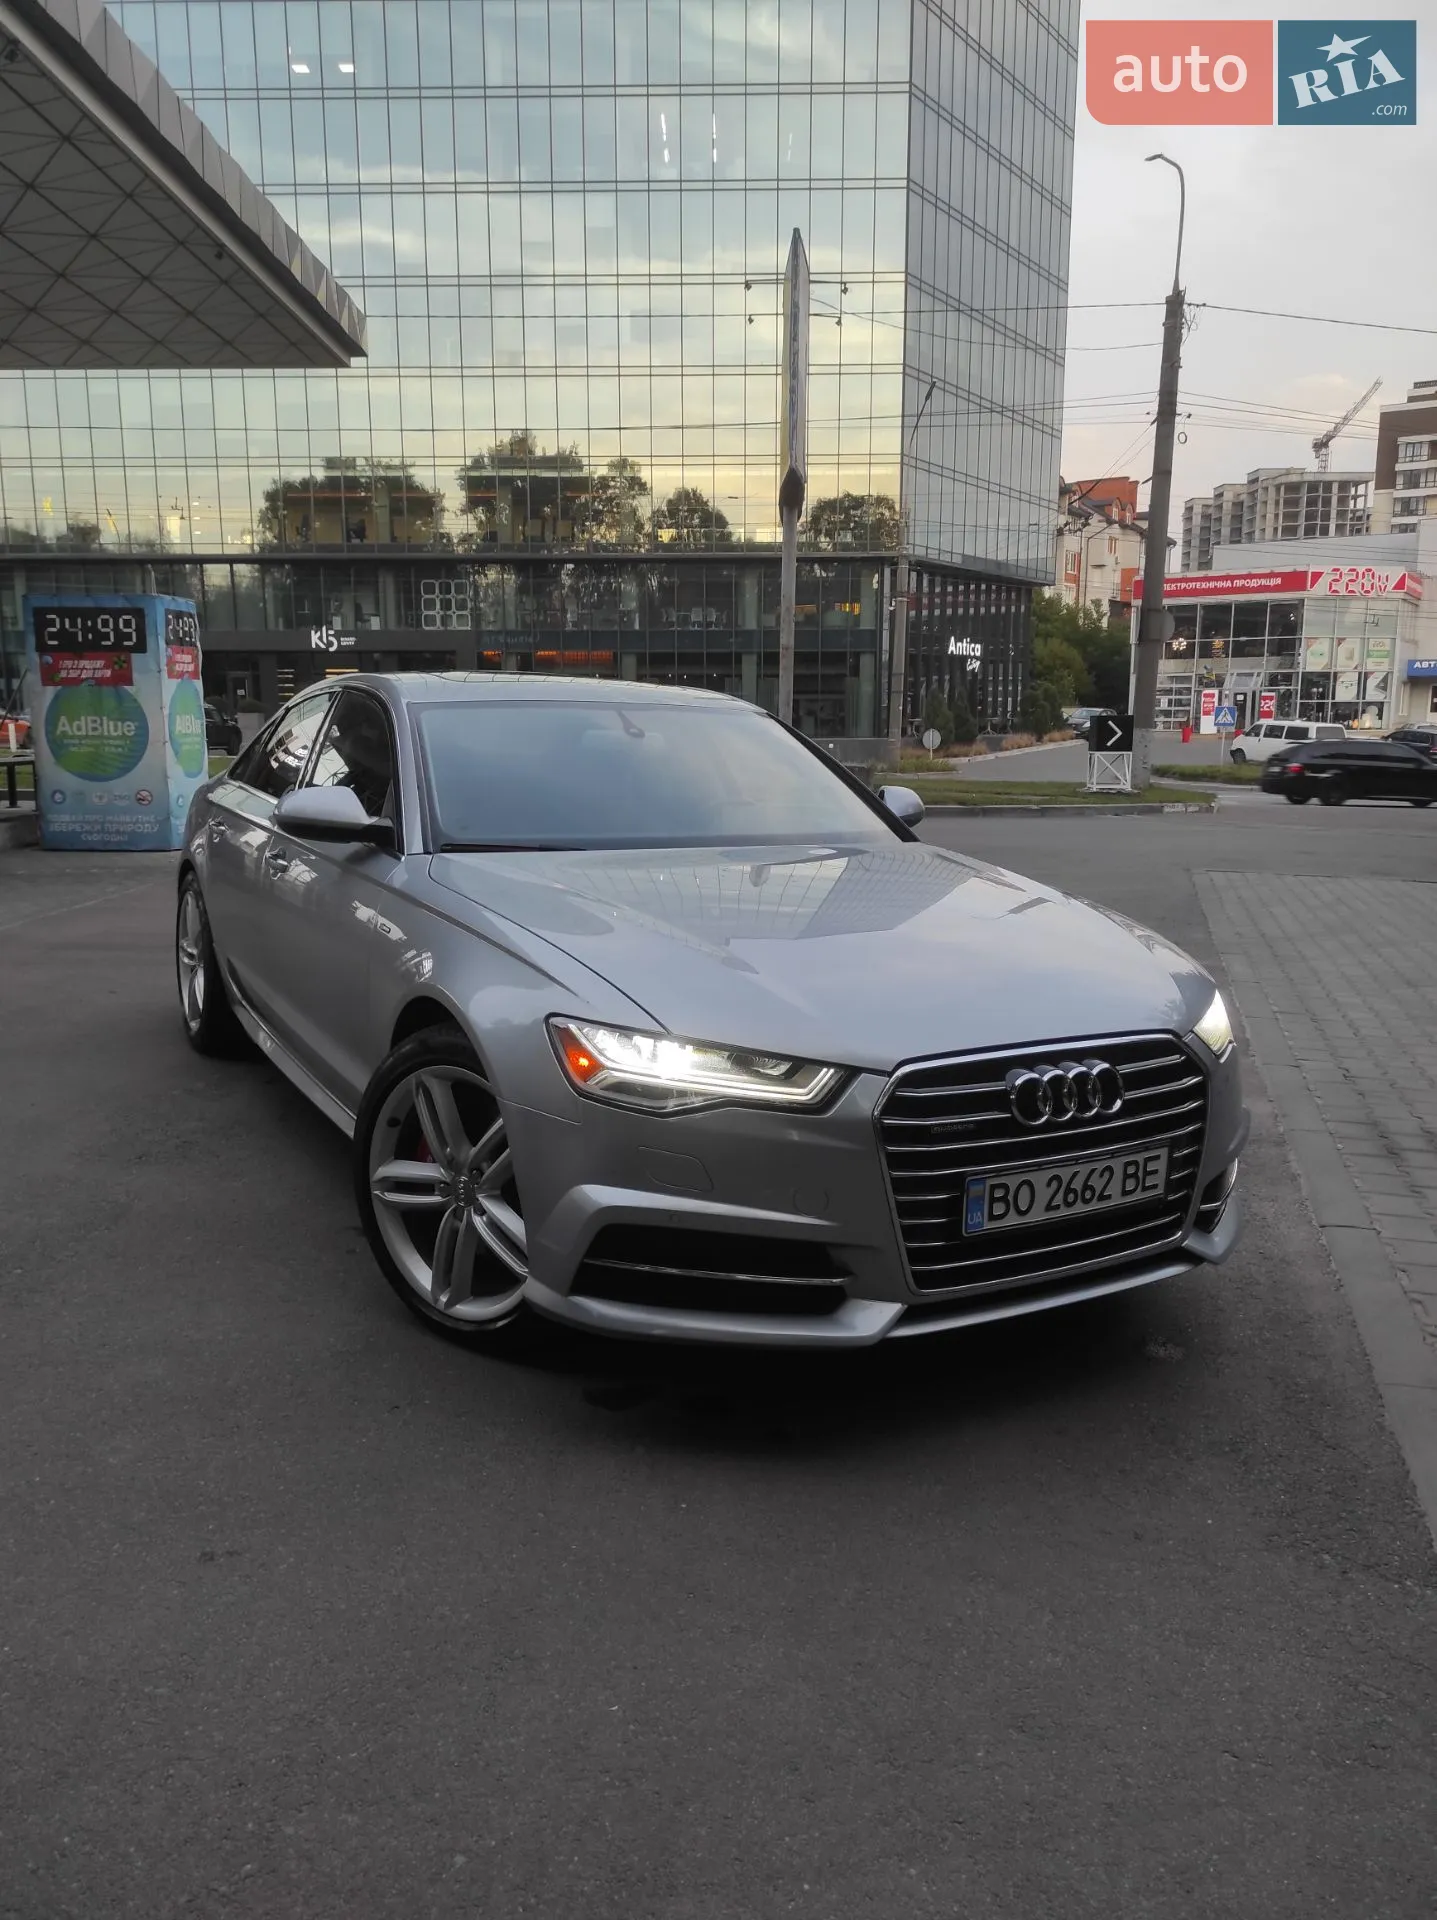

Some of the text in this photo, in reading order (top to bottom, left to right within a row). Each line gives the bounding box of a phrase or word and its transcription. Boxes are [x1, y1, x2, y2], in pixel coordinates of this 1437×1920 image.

[1163, 577, 1282, 591] ЛЕКТРОТЕХНІЧНА ПРОДУКЦІЯ
[44, 614, 137, 646] 24:99
[947, 635, 982, 657] Antica
[1413, 660, 1437, 669] АВТ
[56, 715, 137, 737] AdBlue
[104, 822, 160, 834] ПРИРОДУ
[988, 1153, 1162, 1222] BO 2662 BE
[967, 1212, 983, 1225] UA
